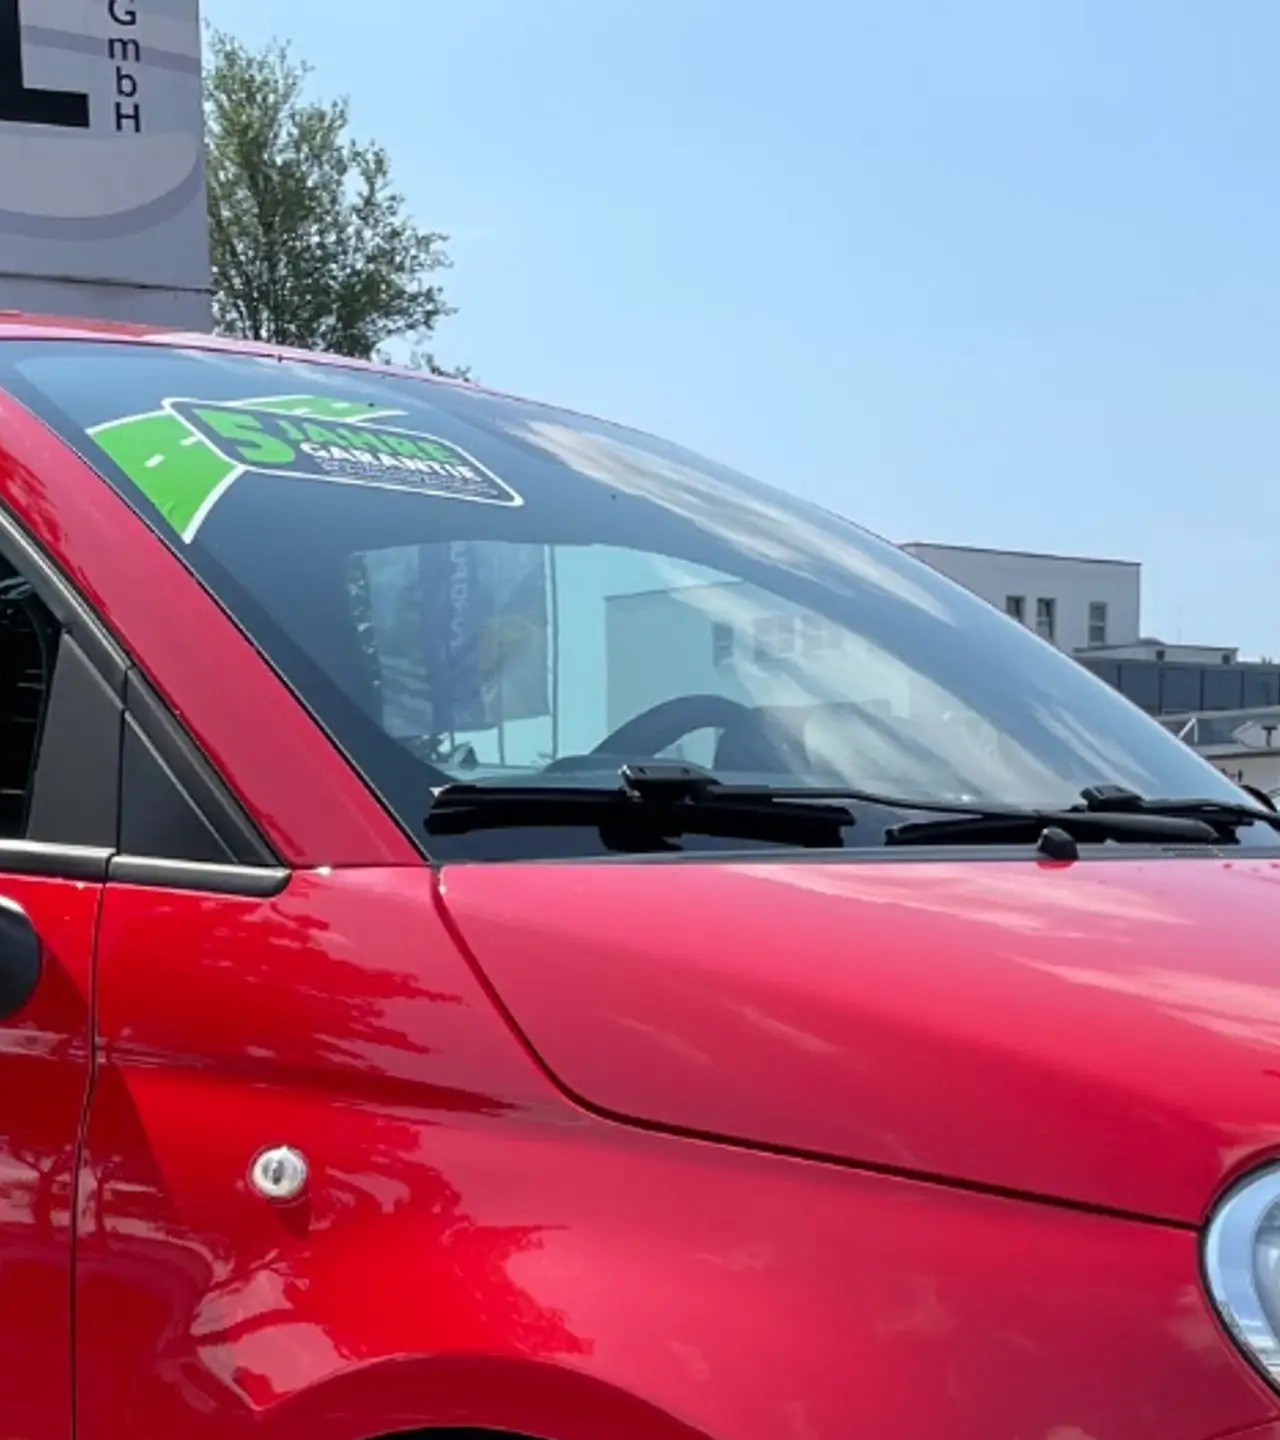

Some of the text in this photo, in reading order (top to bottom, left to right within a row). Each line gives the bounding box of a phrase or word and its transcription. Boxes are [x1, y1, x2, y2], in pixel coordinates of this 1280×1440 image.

[108, 0, 140, 133] GmbH
[192, 407, 459, 464] 5 JAHRE
[300, 441, 483, 482] GARANTIE
